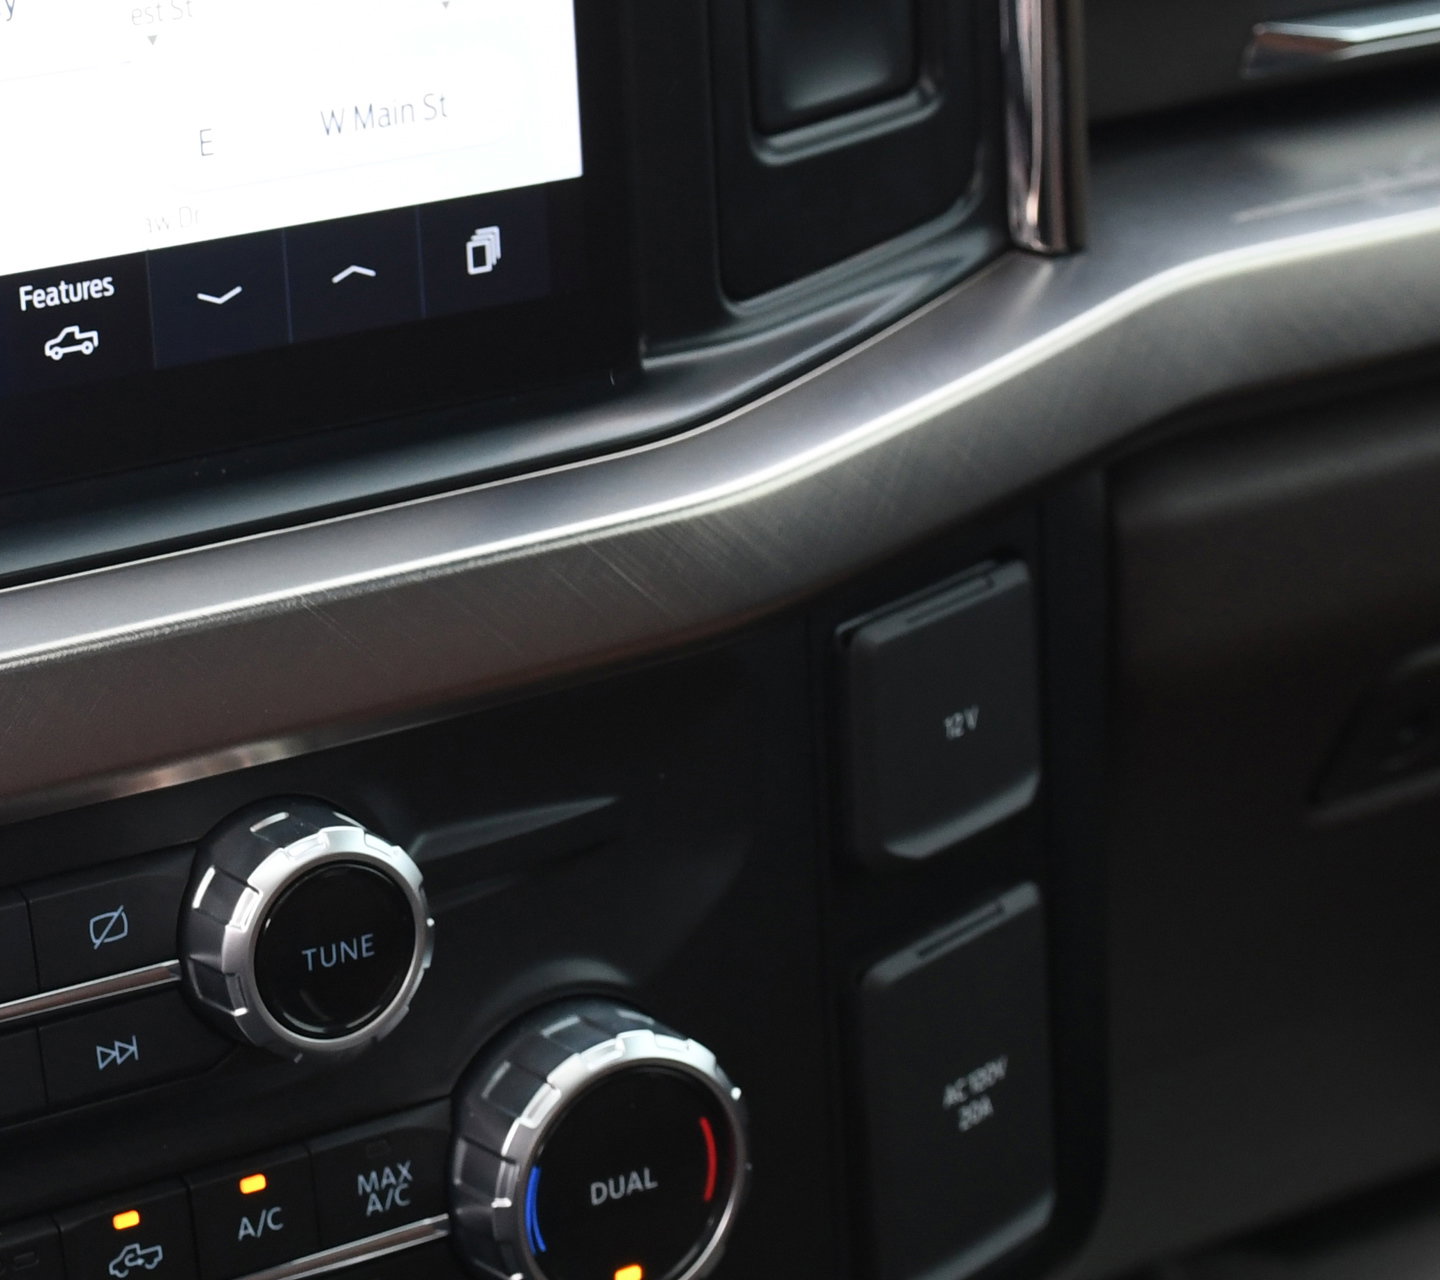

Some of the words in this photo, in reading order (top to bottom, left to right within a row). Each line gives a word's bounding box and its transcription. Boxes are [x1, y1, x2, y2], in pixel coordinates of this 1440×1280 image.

[130, 6, 165, 27] est
[321, 110, 344, 136] W
[354, 104, 414, 130] Main
[423, 93, 447, 120] St
[200, 128, 214, 156] E
[18, 273, 115, 312] Features
[302, 934, 374, 970] TUNE
[357, 1160, 413, 1196] MAX
[591, 1168, 657, 1205] DUAL
[365, 1182, 411, 1217] A/C
[239, 1207, 282, 1240] A/C
